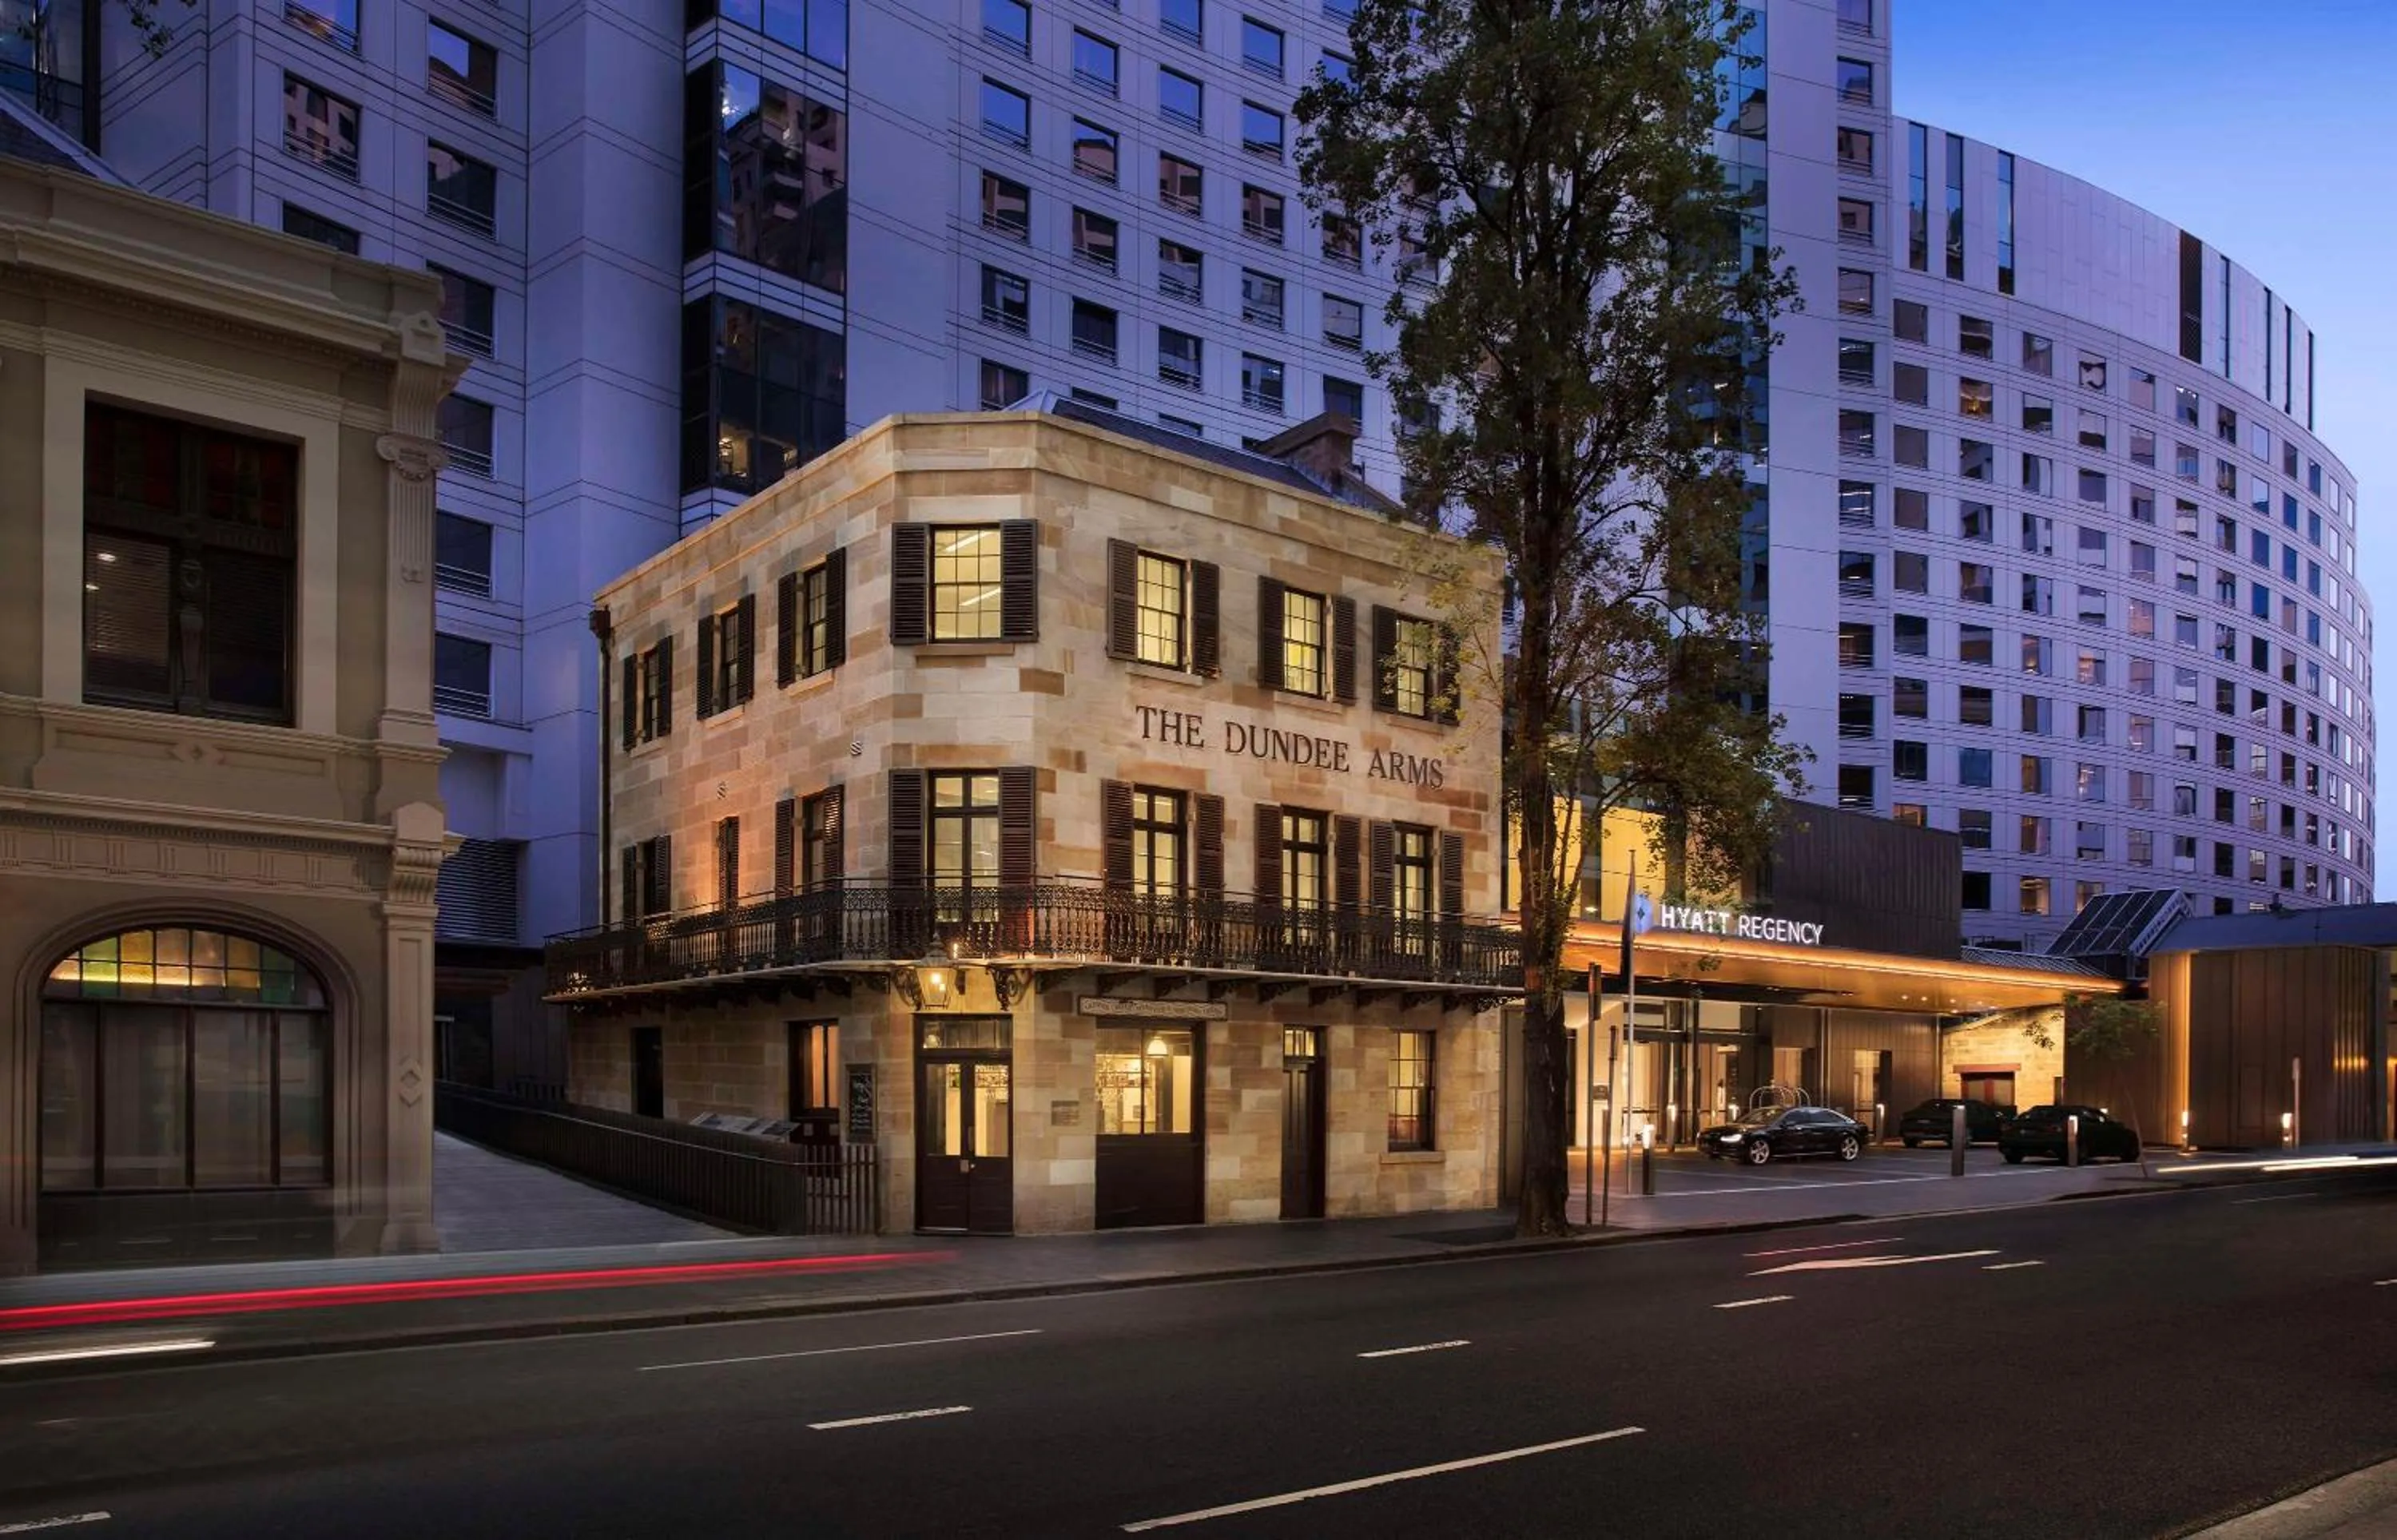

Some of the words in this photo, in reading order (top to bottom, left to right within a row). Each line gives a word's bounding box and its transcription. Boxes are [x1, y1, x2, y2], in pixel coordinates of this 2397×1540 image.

[1135, 705, 1205, 749] THE
[1224, 720, 1350, 773] DUNDEE
[1367, 748, 1445, 790] ARMS
[1661, 903, 1730, 935] HYATT
[1738, 914, 1824, 945] REGENCY
